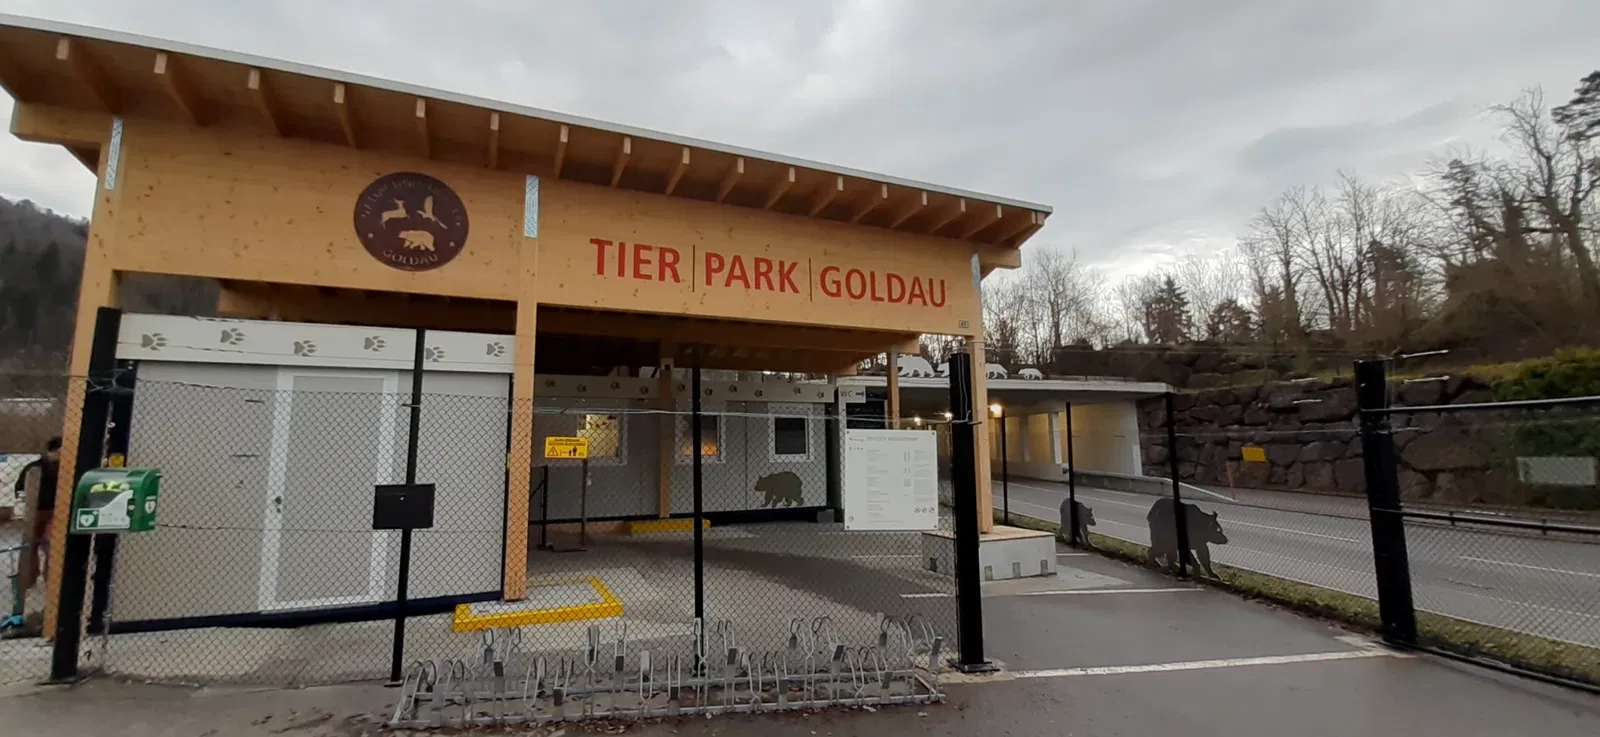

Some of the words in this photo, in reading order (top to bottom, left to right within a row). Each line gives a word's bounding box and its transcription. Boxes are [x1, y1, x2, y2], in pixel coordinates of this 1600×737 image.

[590, 238, 681, 284] TIER
[704, 252, 800, 294] PARK
[819, 265, 946, 308] GOLDAU
